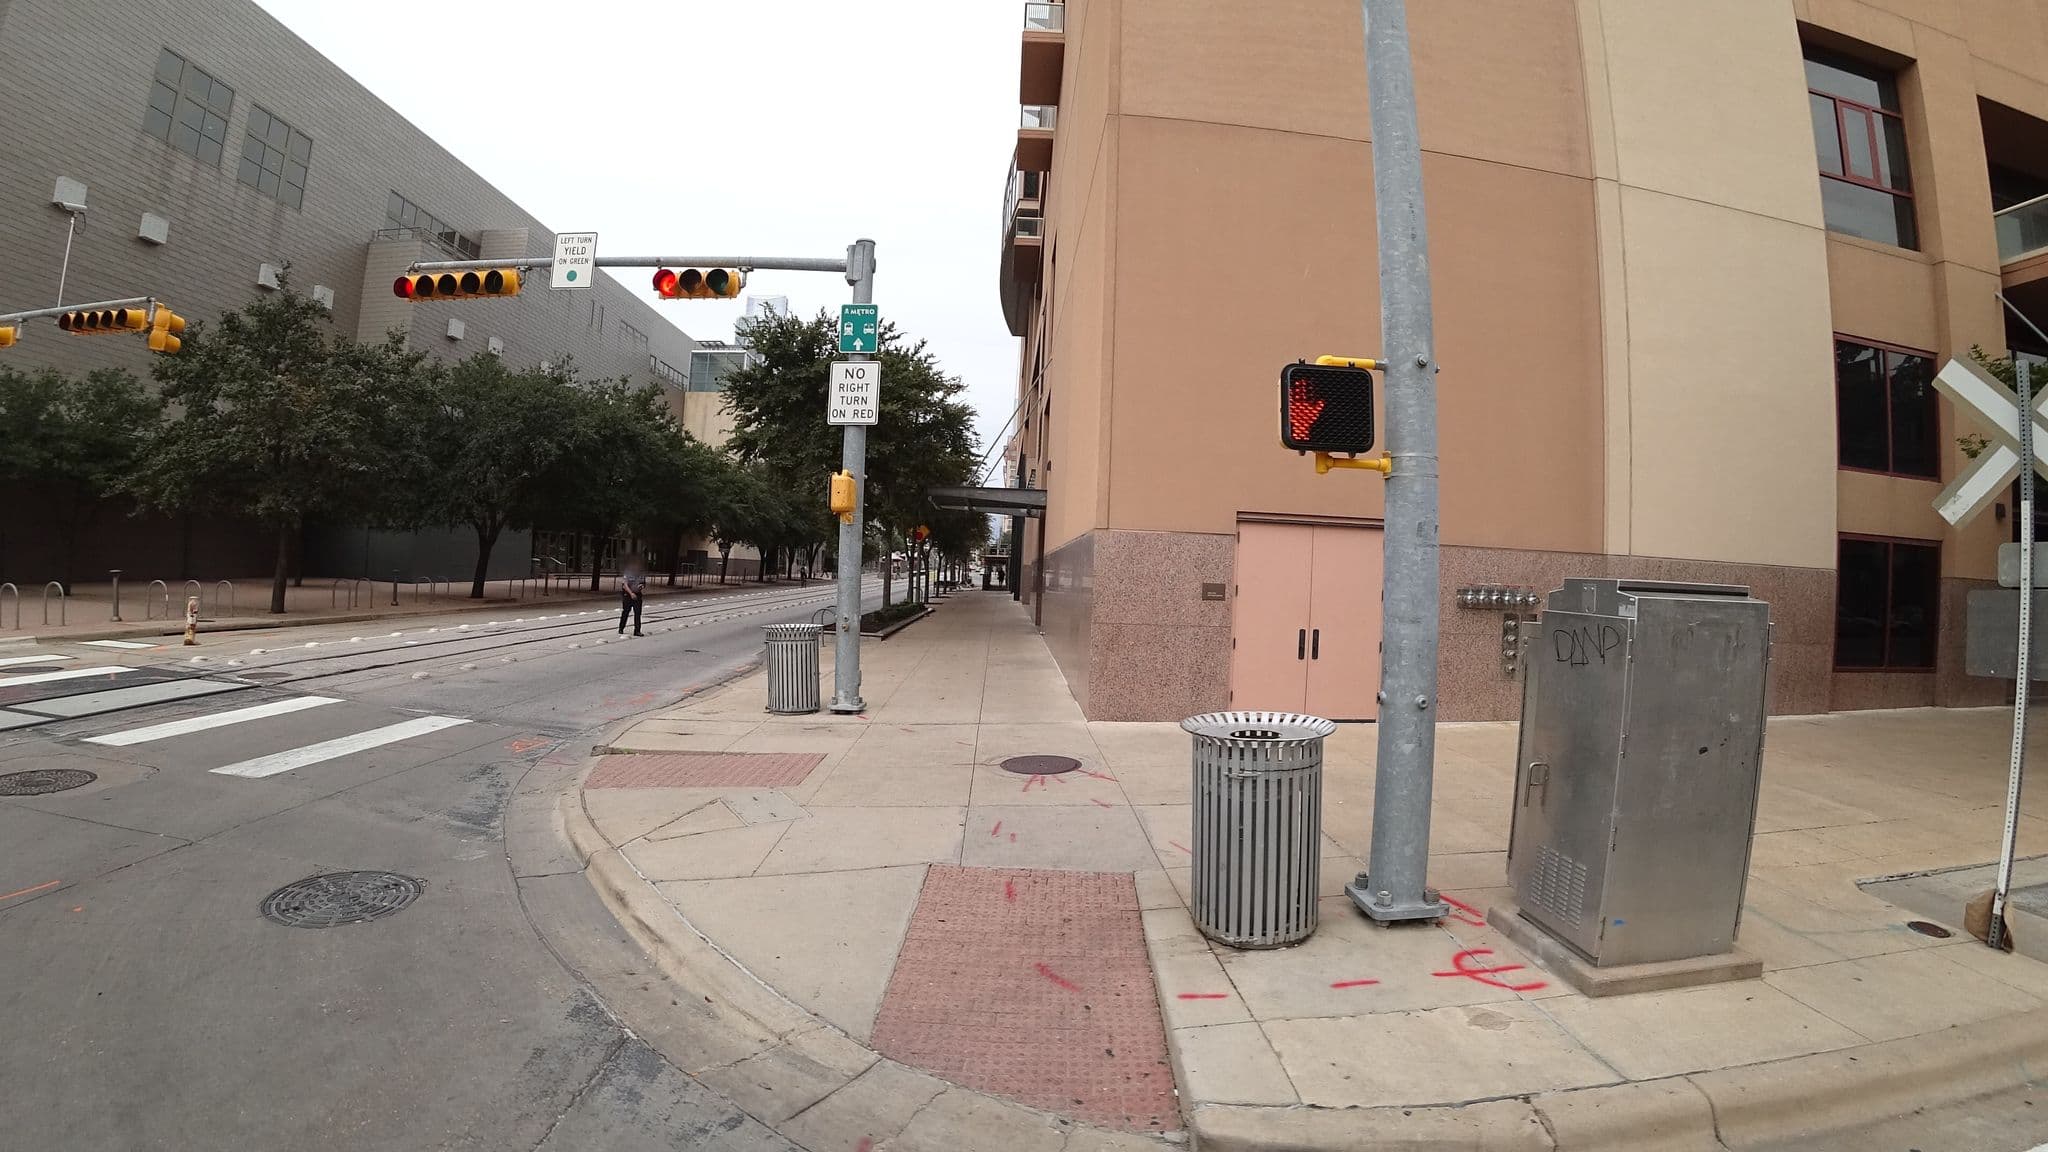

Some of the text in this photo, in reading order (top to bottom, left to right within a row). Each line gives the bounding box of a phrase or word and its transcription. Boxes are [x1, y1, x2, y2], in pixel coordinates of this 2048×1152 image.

[564, 246, 587, 256] YIELD
[570, 257, 589, 265] GREEN
[850, 308, 875, 316] METRO
[844, 367, 866, 380] NO
[838, 382, 871, 393] RIGHT
[840, 395, 868, 406] TURN
[831, 408, 874, 419] ON RED
